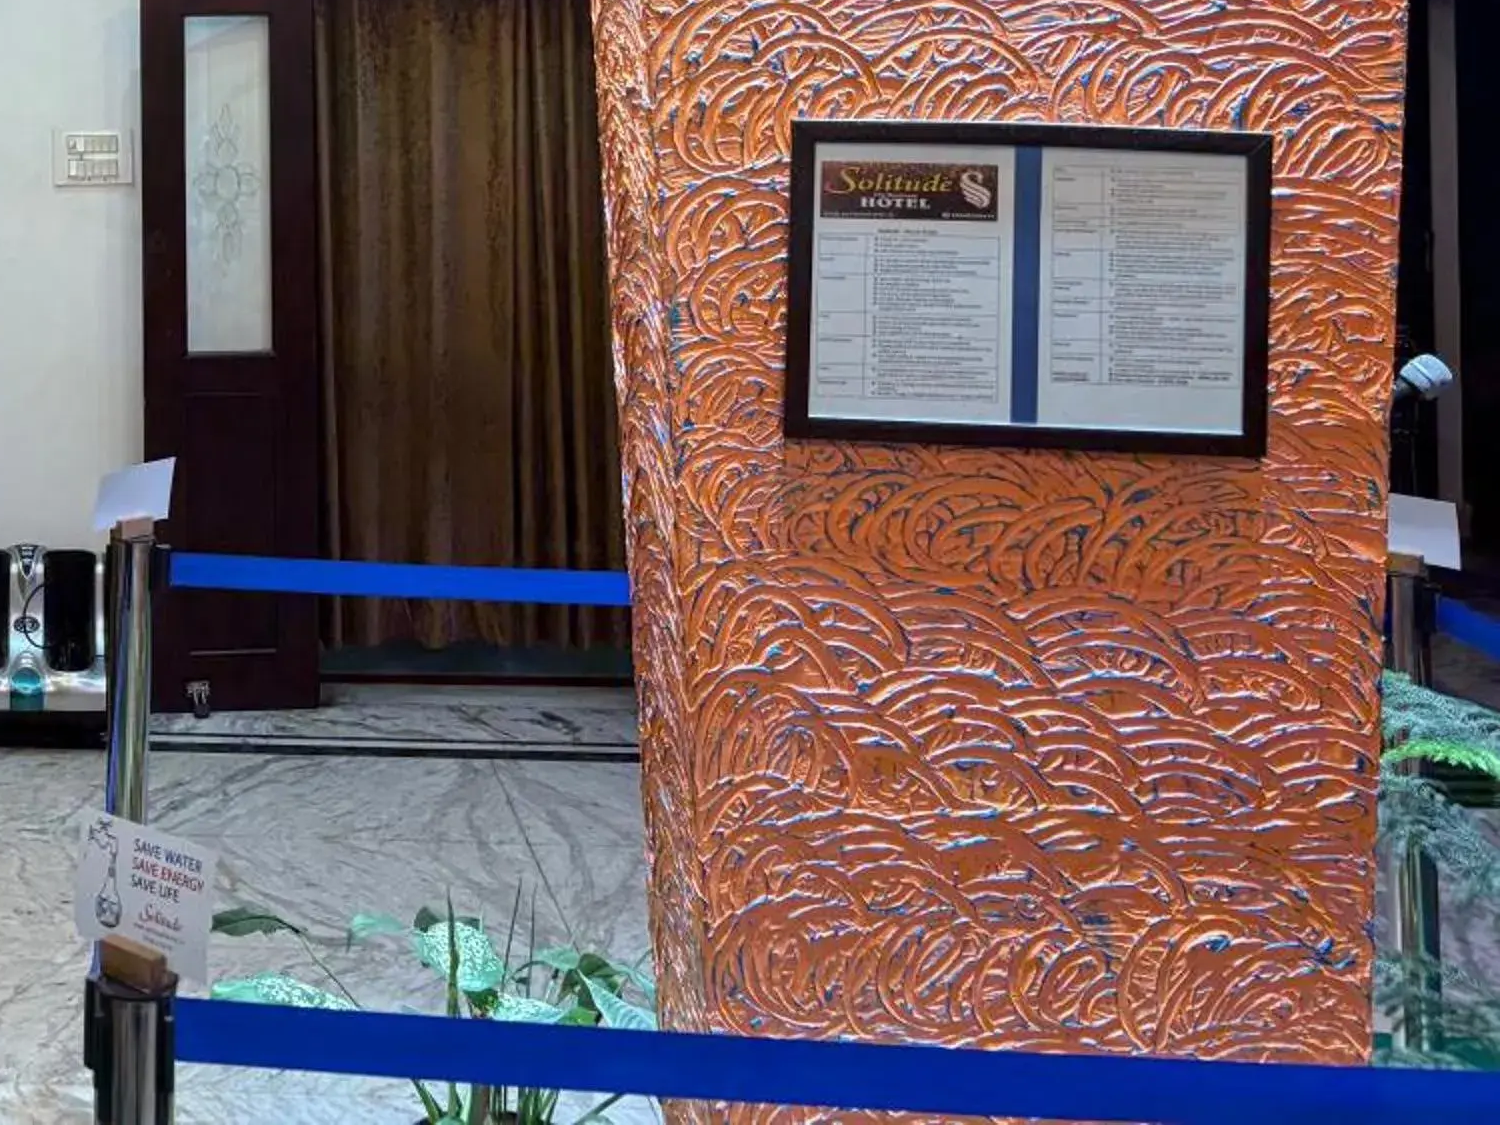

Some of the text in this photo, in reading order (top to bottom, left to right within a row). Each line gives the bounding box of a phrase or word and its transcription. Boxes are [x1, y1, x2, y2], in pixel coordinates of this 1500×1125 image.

[824, 166, 953, 195] Solitude
[859, 197, 932, 210] HOTEL
[133, 837, 204, 873] SAVE WATER
[130, 874, 181, 904] SAVE LIFE
[131, 856, 205, 895] SAVE ENERGY
